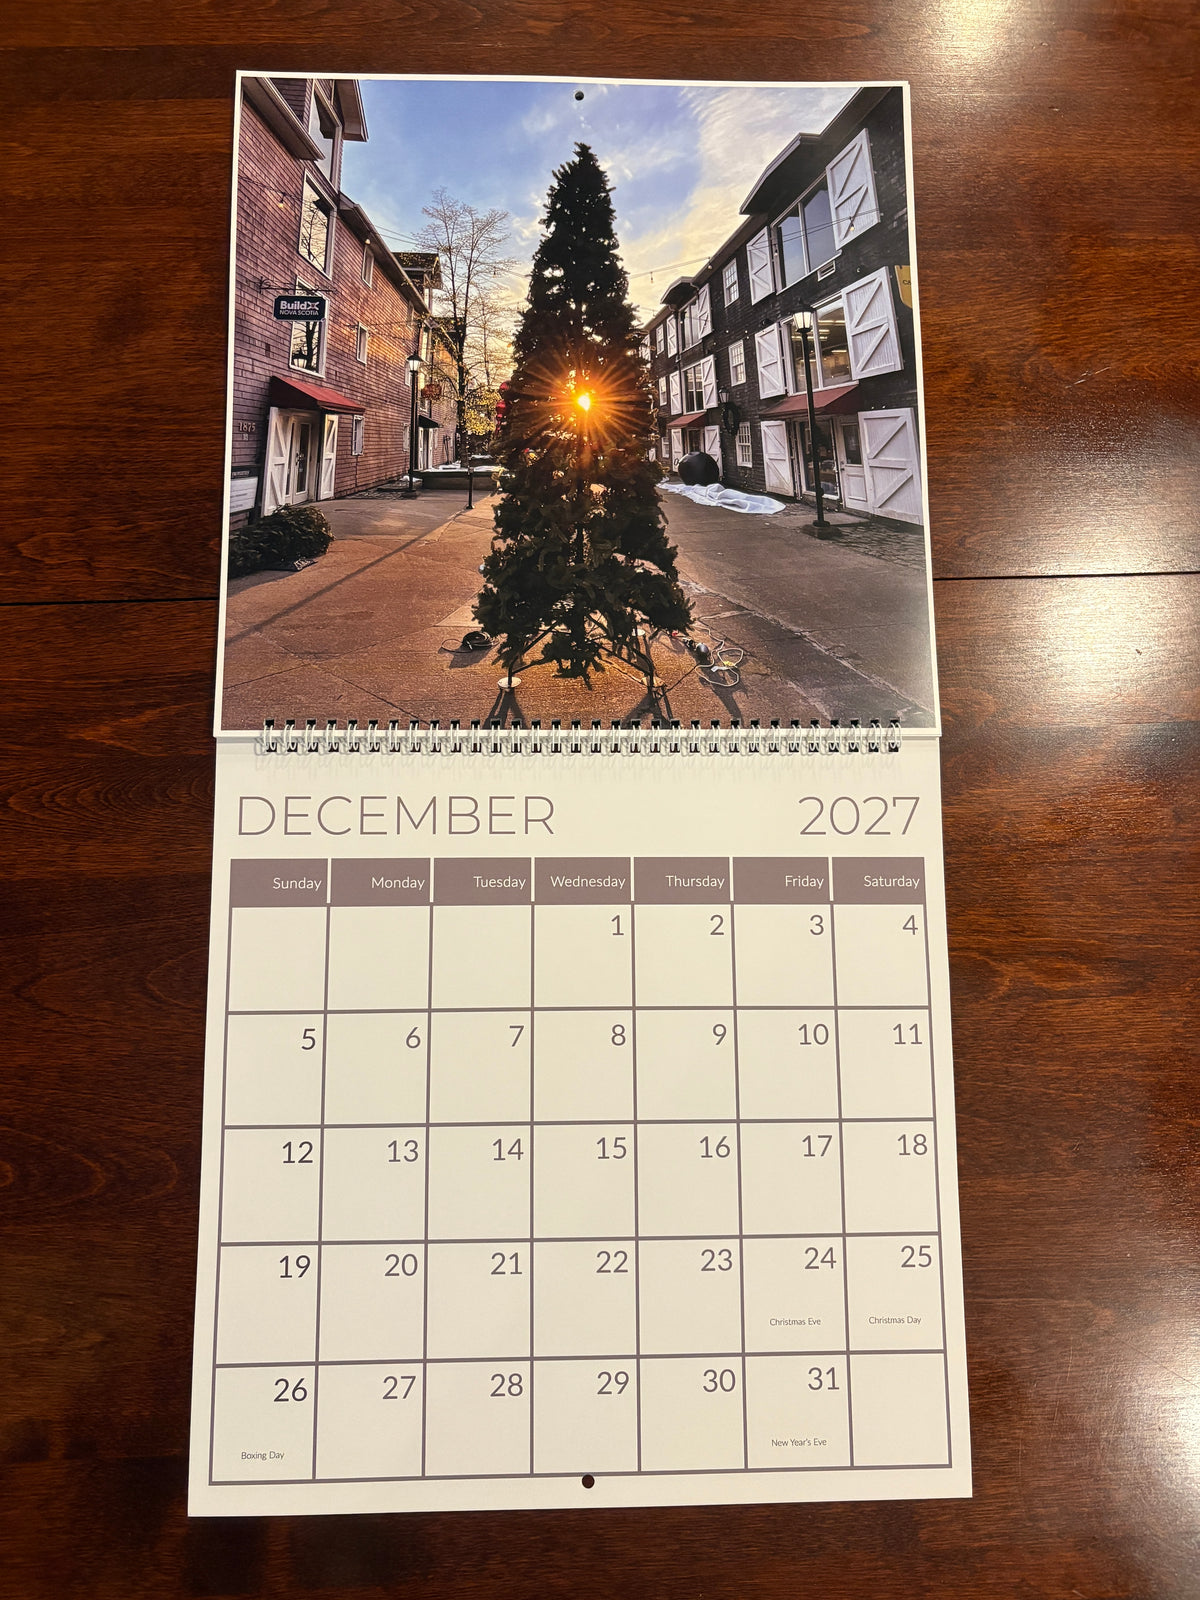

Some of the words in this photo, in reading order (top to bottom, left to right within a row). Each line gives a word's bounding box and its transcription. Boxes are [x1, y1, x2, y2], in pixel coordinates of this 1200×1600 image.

[239, 421, 256, 433] 1875
[238, 795, 555, 836] DECEMBER
[798, 796, 920, 836] 2027
[272, 876, 322, 892] Sunday
[371, 876, 426, 891] Monday
[473, 875, 526, 890] Tuesday
[550, 875, 626, 890] Wednesday
[665, 875, 725, 889] Thursday
[785, 874, 825, 890] Friday
[863, 875, 921, 890] Saturday
[611, 914, 625, 936] 1
[710, 914, 725, 936] 2
[809, 914, 825, 936] 3
[902, 914, 919, 936] 4
[301, 1028, 316, 1051] 5
[405, 1026, 421, 1049] 6
[509, 1025, 525, 1048] 7
[611, 1024, 626, 1047] 8
[712, 1023, 727, 1046] 9
[798, 1023, 829, 1046] 10
[892, 1023, 923, 1045] 11
[282, 1140, 314, 1164] 12
[387, 1139, 419, 1163] 13
[492, 1138, 524, 1161] 14
[596, 1136, 627, 1160] 15
[699, 1135, 731, 1159] 16
[802, 1134, 833, 1157] 17
[897, 1133, 928, 1156] 18
[279, 1254, 311, 1279] 19
[384, 1253, 418, 1277] 20
[490, 1252, 523, 1276] 21
[596, 1250, 629, 1274] 22
[700, 1248, 733, 1272] 23
[804, 1246, 837, 1270] 24
[900, 1245, 932, 1268] 25
[769, 1318, 806, 1327] Christmas
[807, 1317, 821, 1326] Eve
[868, 1316, 905, 1325] Christmas
[906, 1315, 922, 1326] Day
[273, 1377, 308, 1403] 26
[382, 1375, 417, 1400] 27
[489, 1372, 524, 1398] 28
[596, 1370, 630, 1395] 29
[702, 1368, 736, 1393] 30
[807, 1366, 840, 1391] 31
[771, 1439, 789, 1447] New
[789, 1438, 812, 1447] Year's
[813, 1437, 827, 1446] Eve
[241, 1451, 267, 1461] Boxing
[269, 1450, 285, 1460] Day
